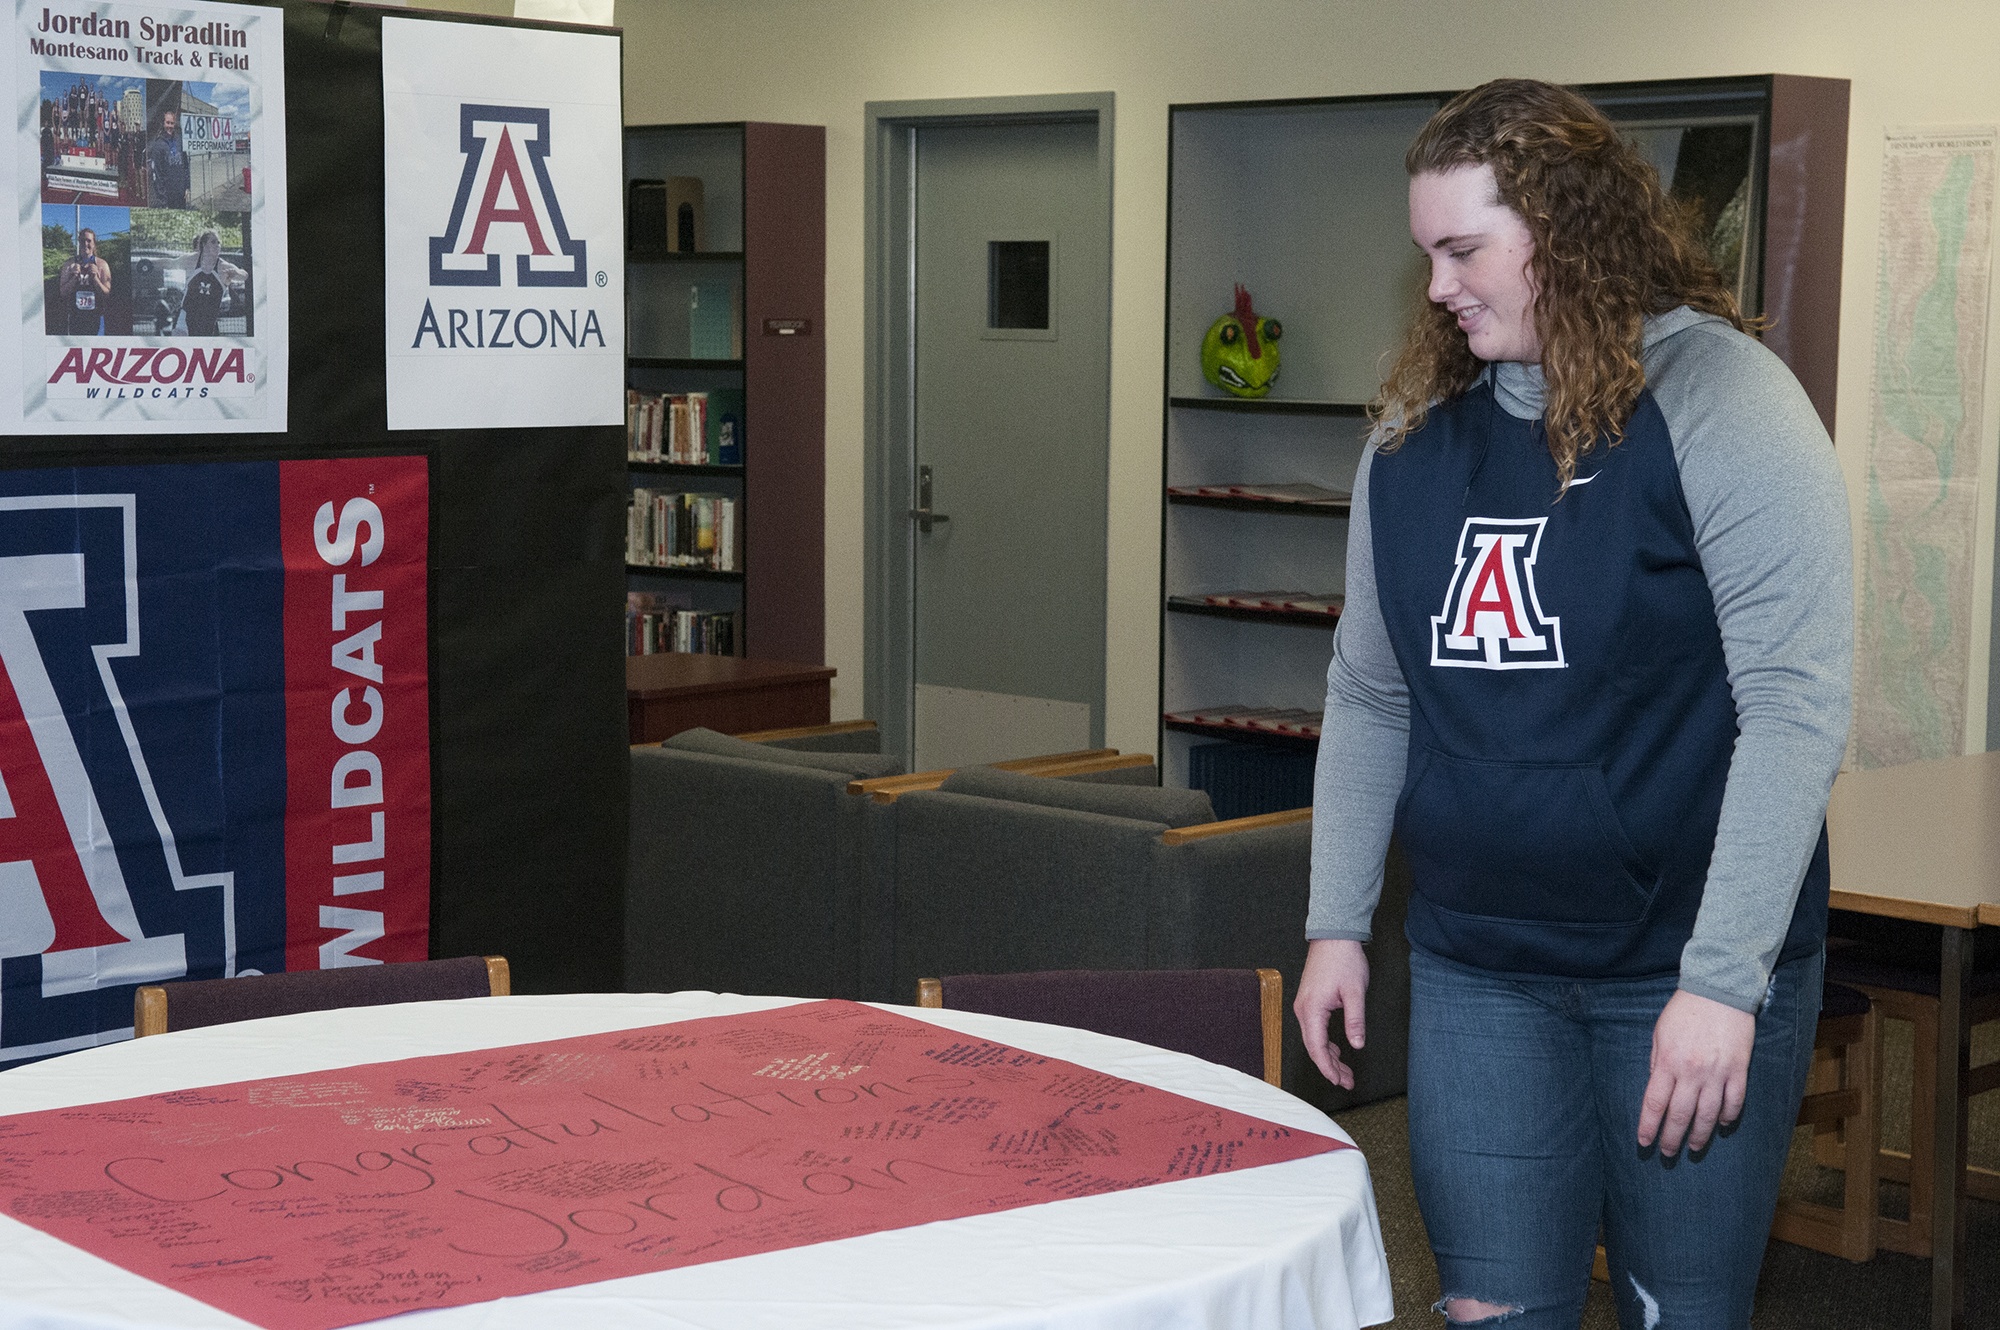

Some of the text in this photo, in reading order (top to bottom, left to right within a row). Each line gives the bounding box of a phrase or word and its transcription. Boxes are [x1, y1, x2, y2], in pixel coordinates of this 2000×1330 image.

[38, 8, 247, 48] Jordan Spradlin
[30, 38, 249, 70] Montesano Track & Field
[187, 140, 234, 151] PERFORMANCE
[429, 103, 588, 287] A
[411, 297, 606, 349] ARIZONA
[47, 347, 245, 385] ARIZONA
[86, 387, 209, 399] WILDCATS
[1430, 517, 1565, 670] A
[104, 1072, 975, 1204] Congratulations
[447, 1157, 1001, 1258] Jordan
